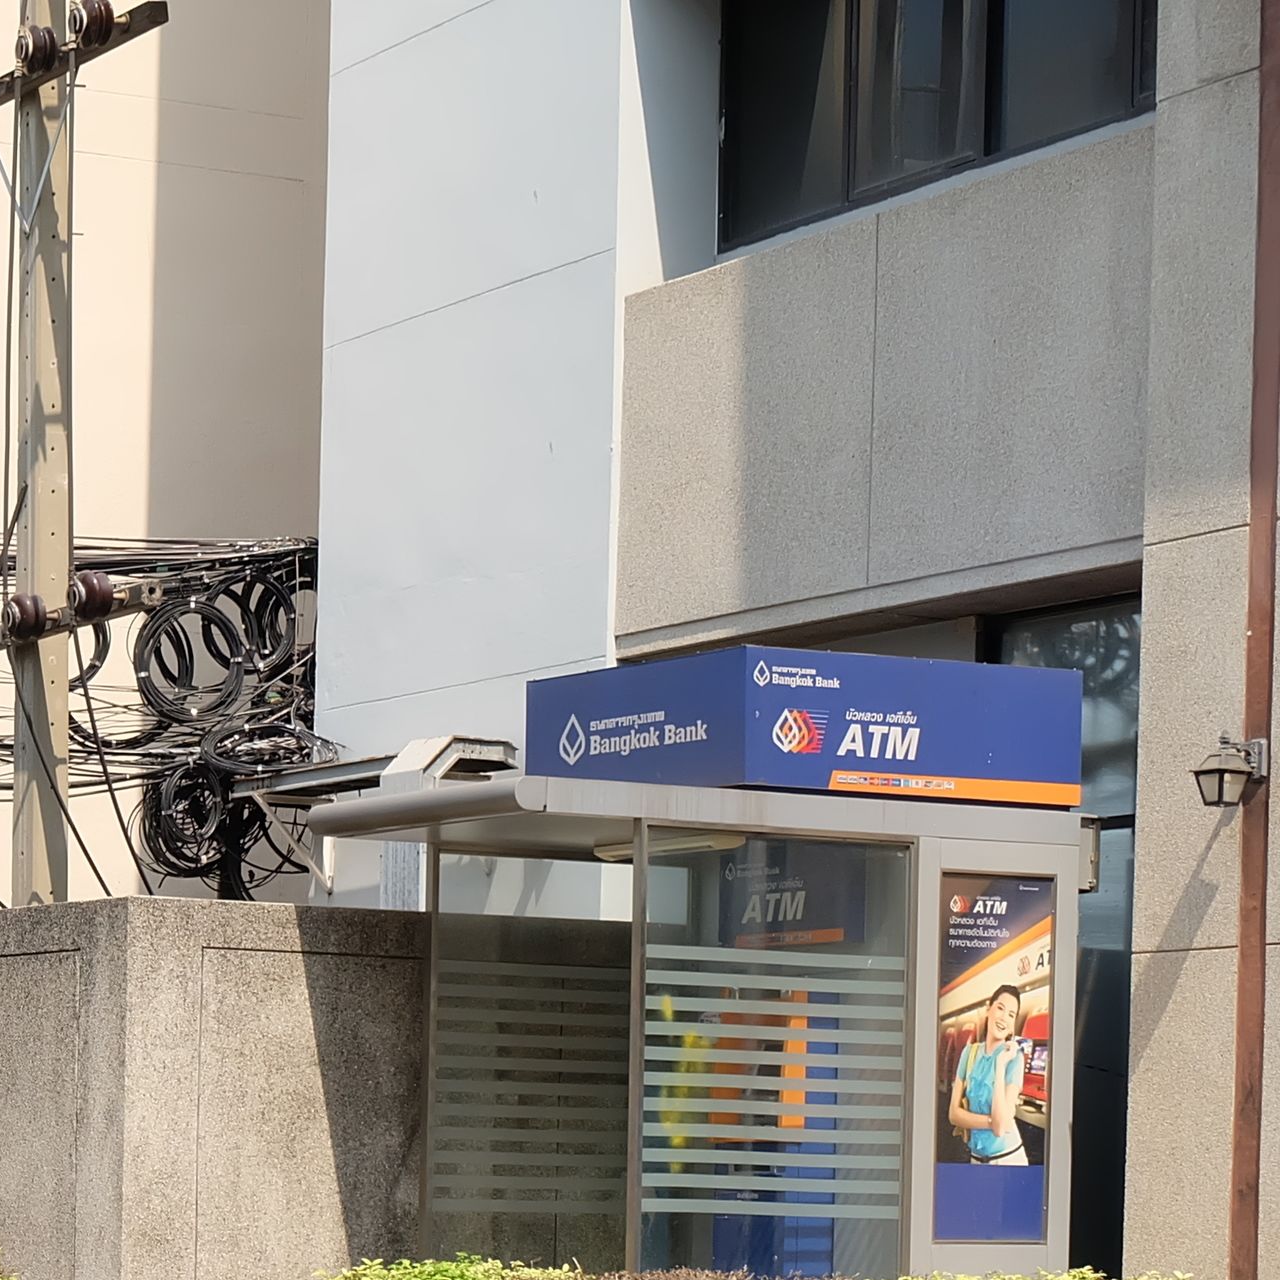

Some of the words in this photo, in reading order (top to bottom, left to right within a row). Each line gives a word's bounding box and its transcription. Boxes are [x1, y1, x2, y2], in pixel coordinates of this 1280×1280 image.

[772, 673, 813, 688] Bangkok
[815, 676, 840, 689] Bank
[845, 708, 884, 723] บัวหลวง
[886, 710, 918, 725] เอทีเอ็ม
[590, 726, 660, 756] Bangkok
[664, 719, 708, 745] Bank
[836, 723, 921, 761] ATM
[741, 890, 806, 924] ATM
[973, 900, 1008, 915] ATM
